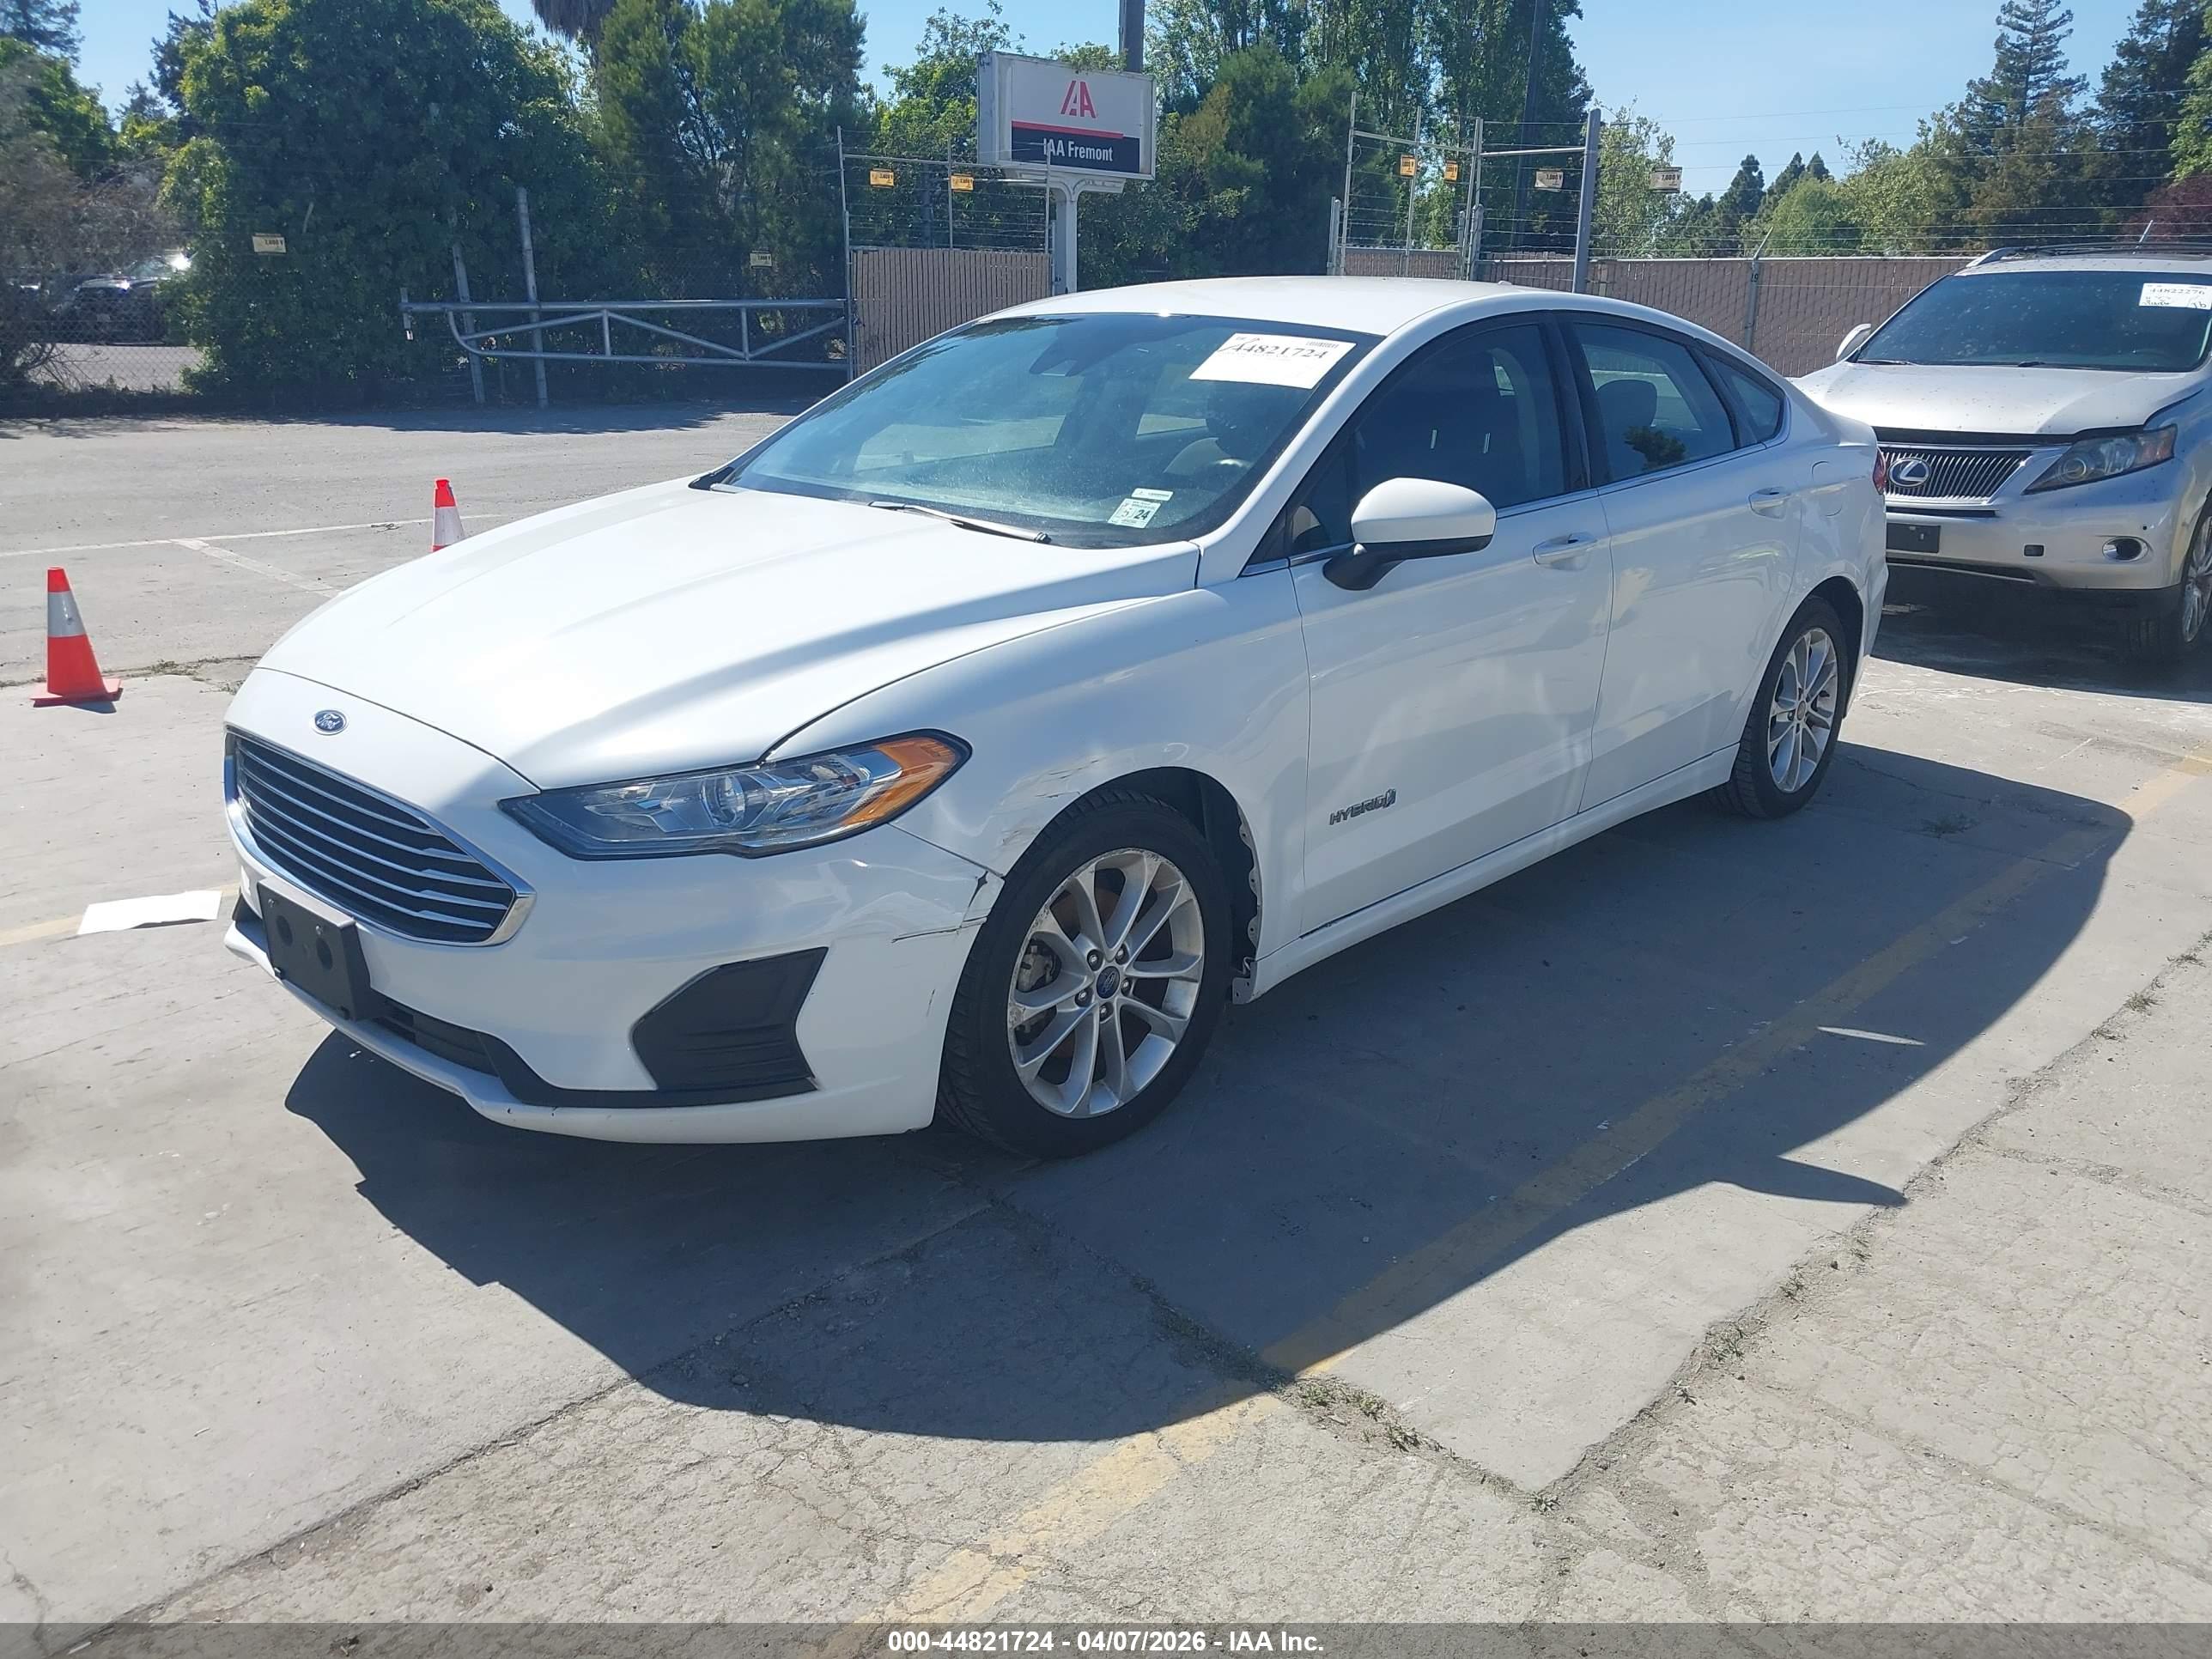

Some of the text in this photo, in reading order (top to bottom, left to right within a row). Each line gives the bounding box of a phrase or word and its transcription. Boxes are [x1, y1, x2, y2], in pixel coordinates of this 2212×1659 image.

[1043, 137, 1114, 162] IAA Fremont
[1231, 343, 1328, 359] 44821724
[1133, 509, 1151, 520] 24
[1329, 794, 1389, 825] HYBRID
